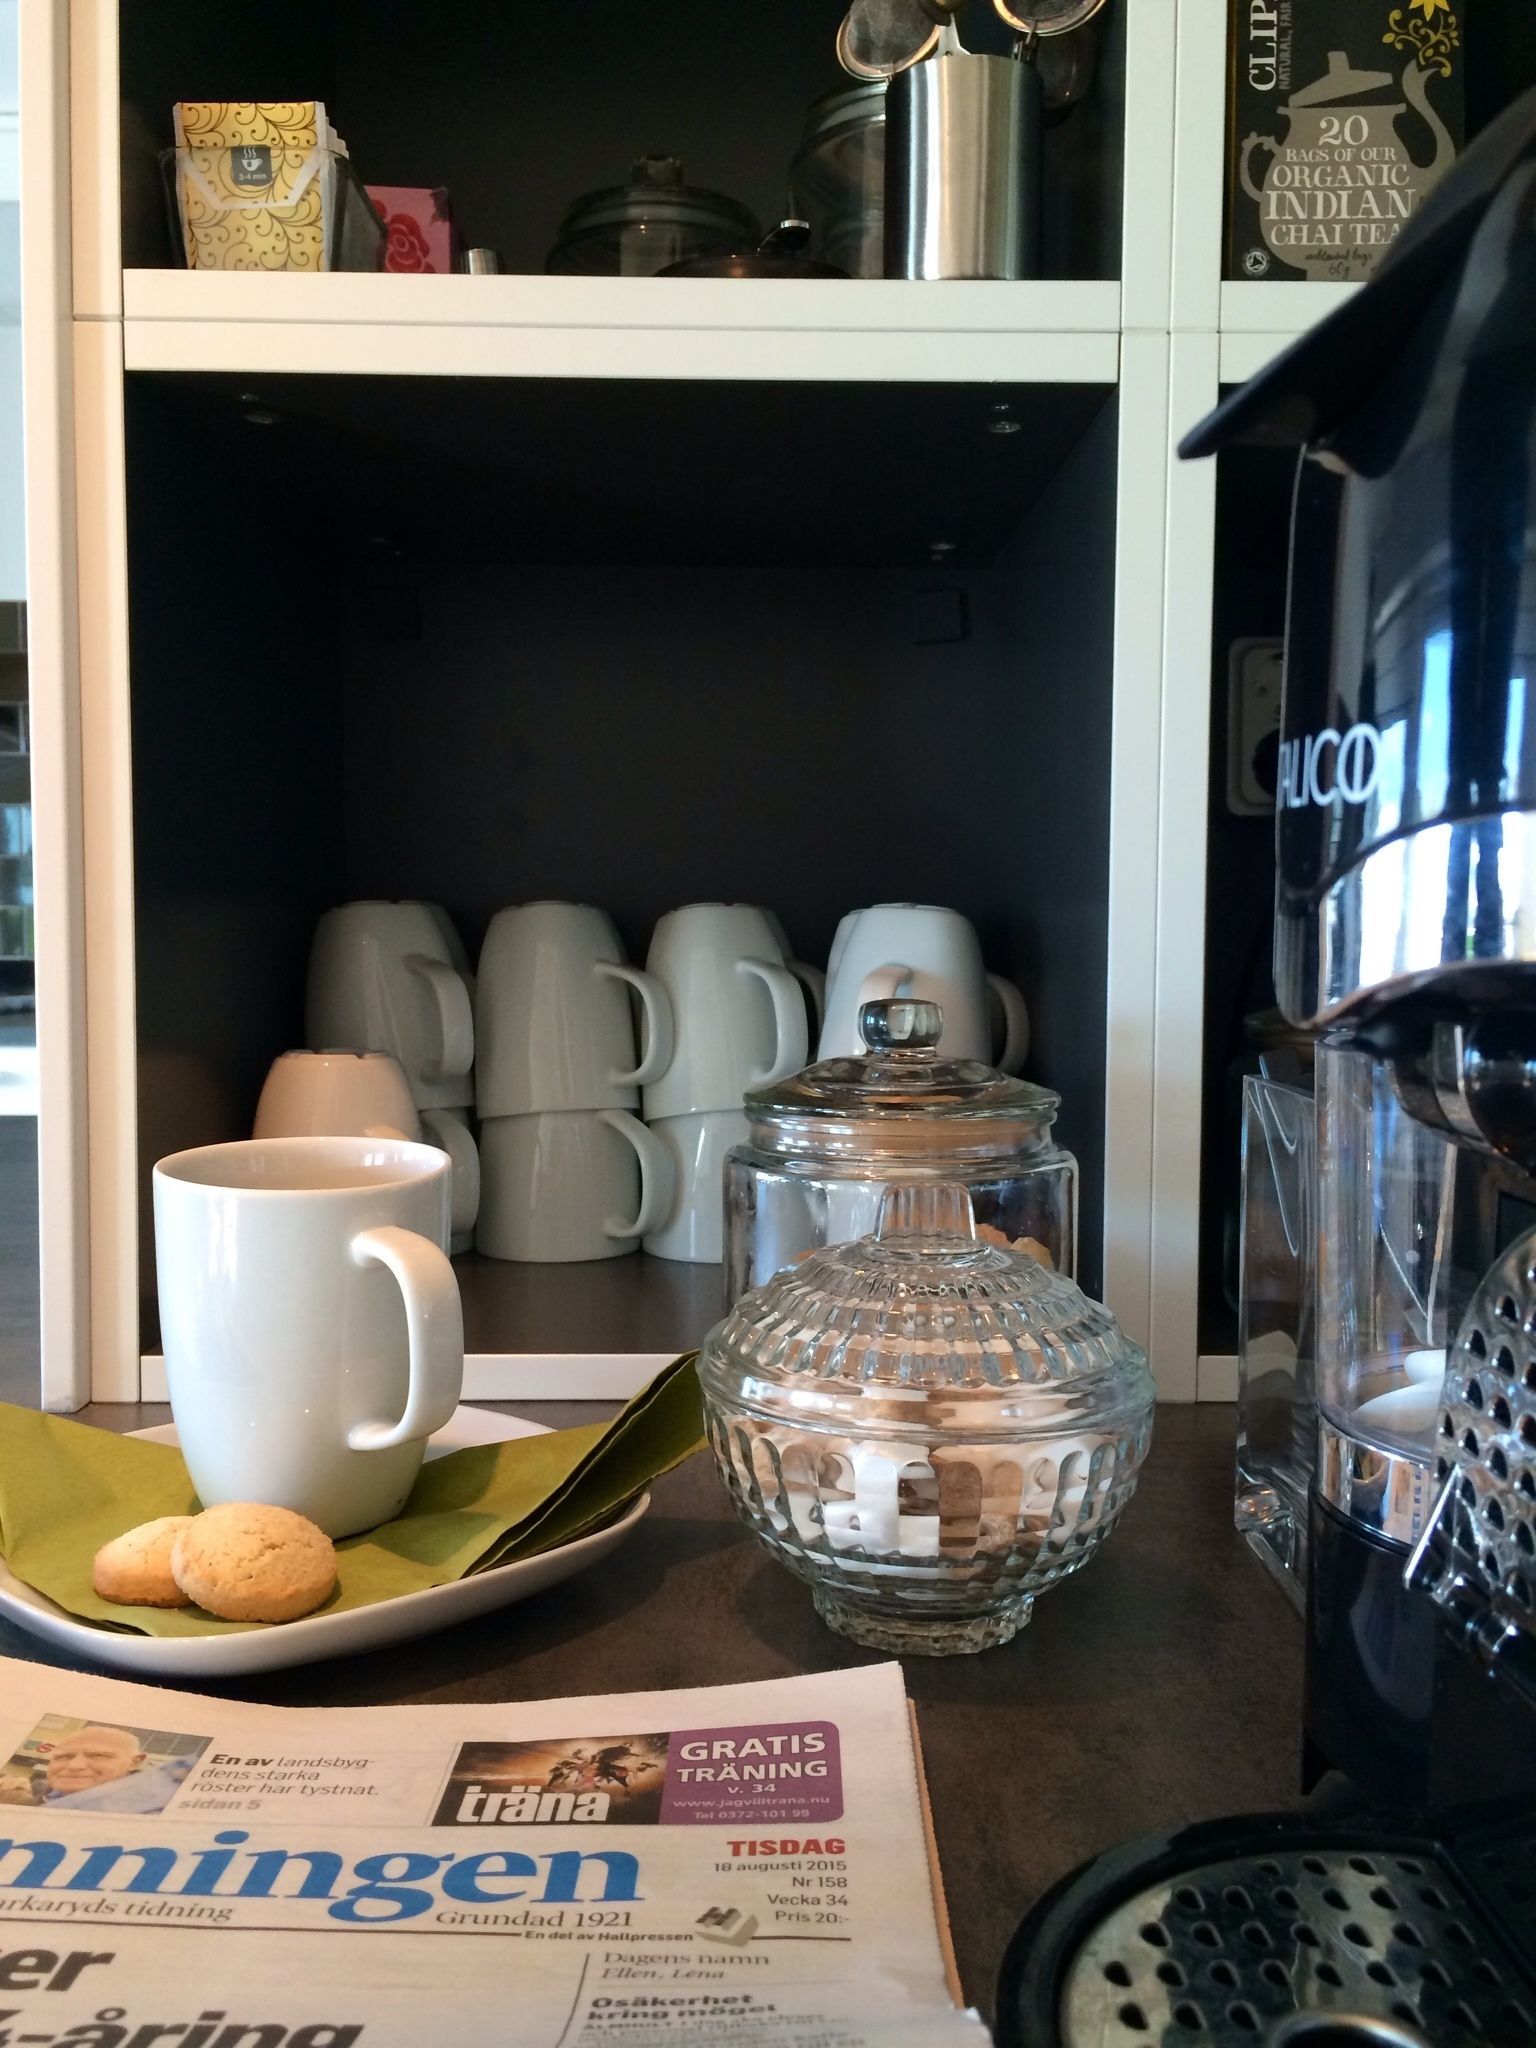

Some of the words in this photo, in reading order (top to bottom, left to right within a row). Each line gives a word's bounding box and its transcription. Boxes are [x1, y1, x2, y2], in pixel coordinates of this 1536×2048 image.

[1318, 114, 1369, 146] 20
[1286, 148, 1330, 162] BAGS
[1334, 147, 1357, 162] OF
[1360, 146, 1398, 162] OUR
[1272, 163, 1410, 188] ORGANIC
[1264, 188, 1417, 220] INDIAN
[1270, 223, 1344, 245] CHAI
[1348, 223, 1401, 245] TEA
[679, 1732, 826, 1762] GRATIS
[210, 1753, 241, 1766] En
[244, 1757, 274, 1767] av
[277, 1756, 376, 1769] landsbyg-
[200, 1768, 250, 1780] dens
[254, 1769, 320, 1781] starka
[676, 1760, 828, 1783] TRÄNING
[190, 1782, 256, 1794] röster
[258, 1783, 298, 1795] har
[300, 1784, 379, 1797] tystnat.
[727, 1786, 744, 1794] v.
[751, 1783, 777, 1793] 34
[177, 1799, 242, 1811] sidan
[247, 1799, 264, 1811] 5
[456, 1785, 611, 1823] träna
[694, 1811, 714, 1820] Tel
[726, 1838, 846, 1857] TISDAG
[714, 1862, 732, 1872] 18
[736, 1861, 802, 1873] augusti
[806, 1860, 847, 1872] 2015
[0, 1830, 645, 1923] nningen
[792, 1876, 814, 1888] Nr
[818, 1876, 848, 1888] 158
[767, 1894, 821, 1906] Vecka
[826, 1894, 848, 1906] 34
[125, 1899, 234, 1923] tidning
[435, 1910, 565, 1928] Grundad
[576, 1911, 632, 1927] 1921
[775, 1910, 811, 1922] Pris
[524, 1930, 545, 1940] En
[548, 1930, 572, 1941] del
[576, 1932, 595, 1941] av
[598, 1931, 694, 1943] Hallpressen
[604, 1951, 692, 1967] Dagens
[697, 1953, 770, 1966] namn
[601, 1966, 664, 1981] Ellen,
[591, 1994, 753, 2009] Osäkerhet
[587, 2009, 670, 2020] kring
[677, 2003, 776, 2018] mögel
